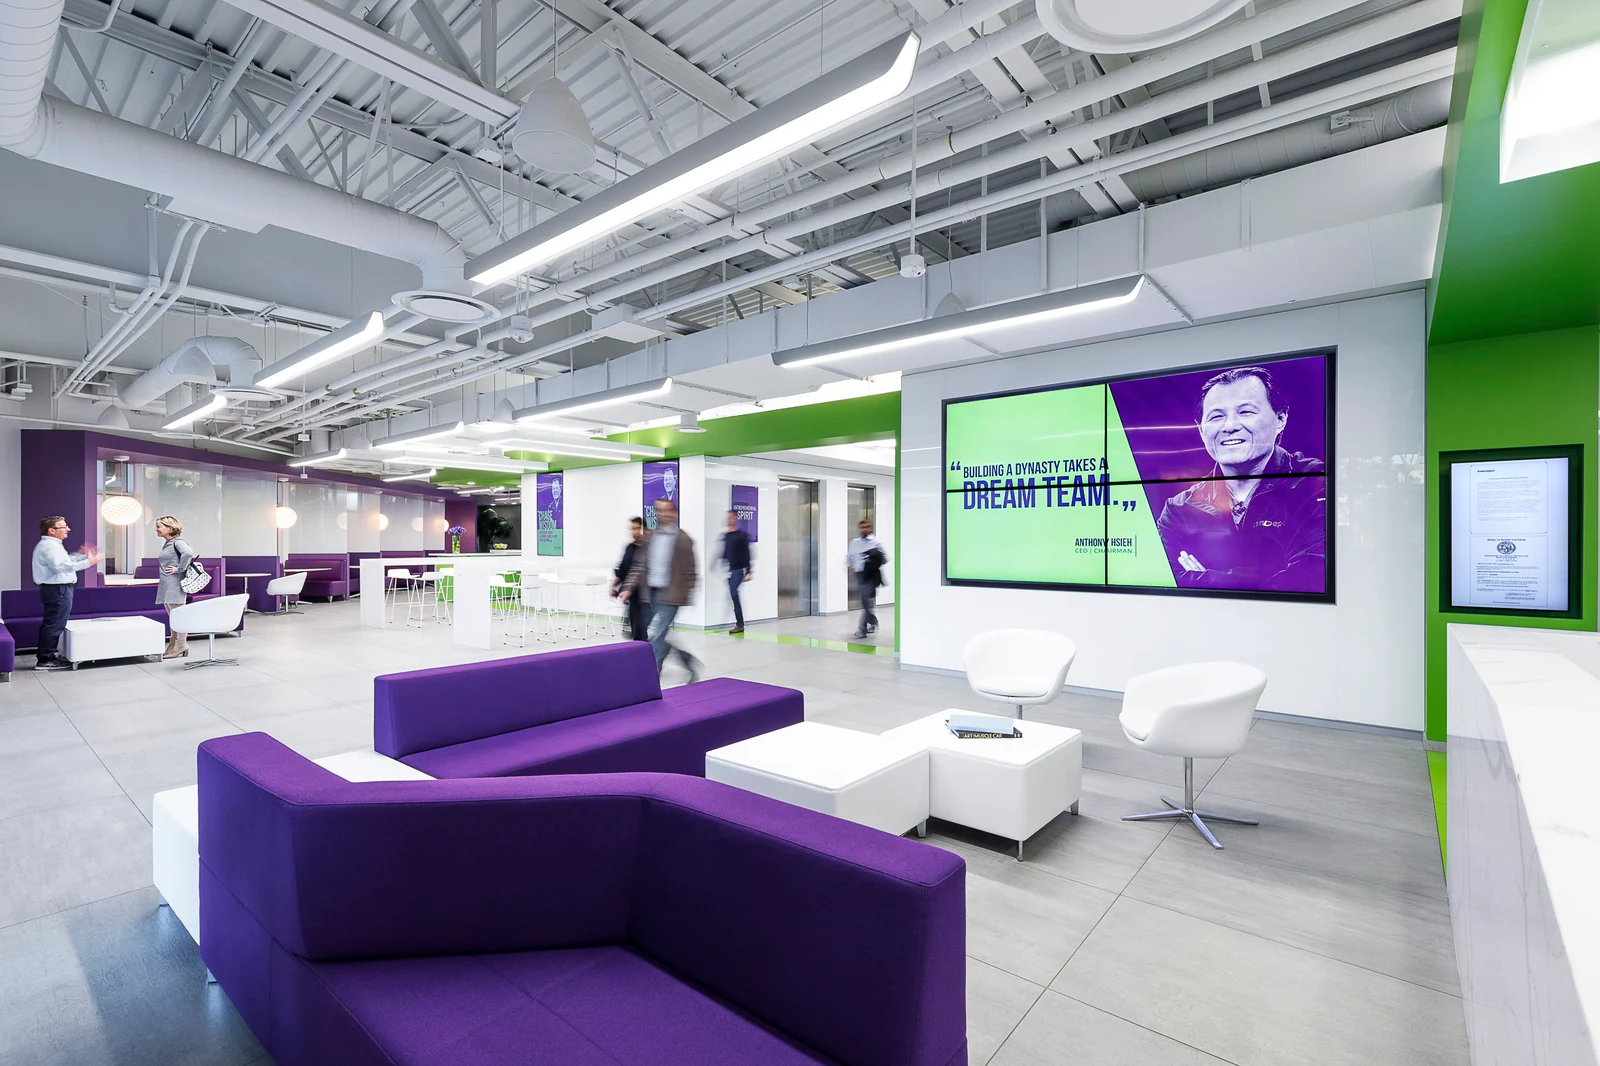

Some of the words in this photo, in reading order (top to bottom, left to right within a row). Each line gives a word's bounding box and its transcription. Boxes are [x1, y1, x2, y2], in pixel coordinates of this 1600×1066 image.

[1006, 464, 1013, 476] A
[1015, 460, 1061, 475] DYNASTY
[1063, 458, 1096, 473] TAKES
[1099, 457, 1109, 470] A
[963, 477, 1036, 510] DREAM
[736, 511, 753, 520] SPIRIT
[1074, 537, 1109, 547] ANTHONY
[1111, 537, 1132, 547] HSIEH
